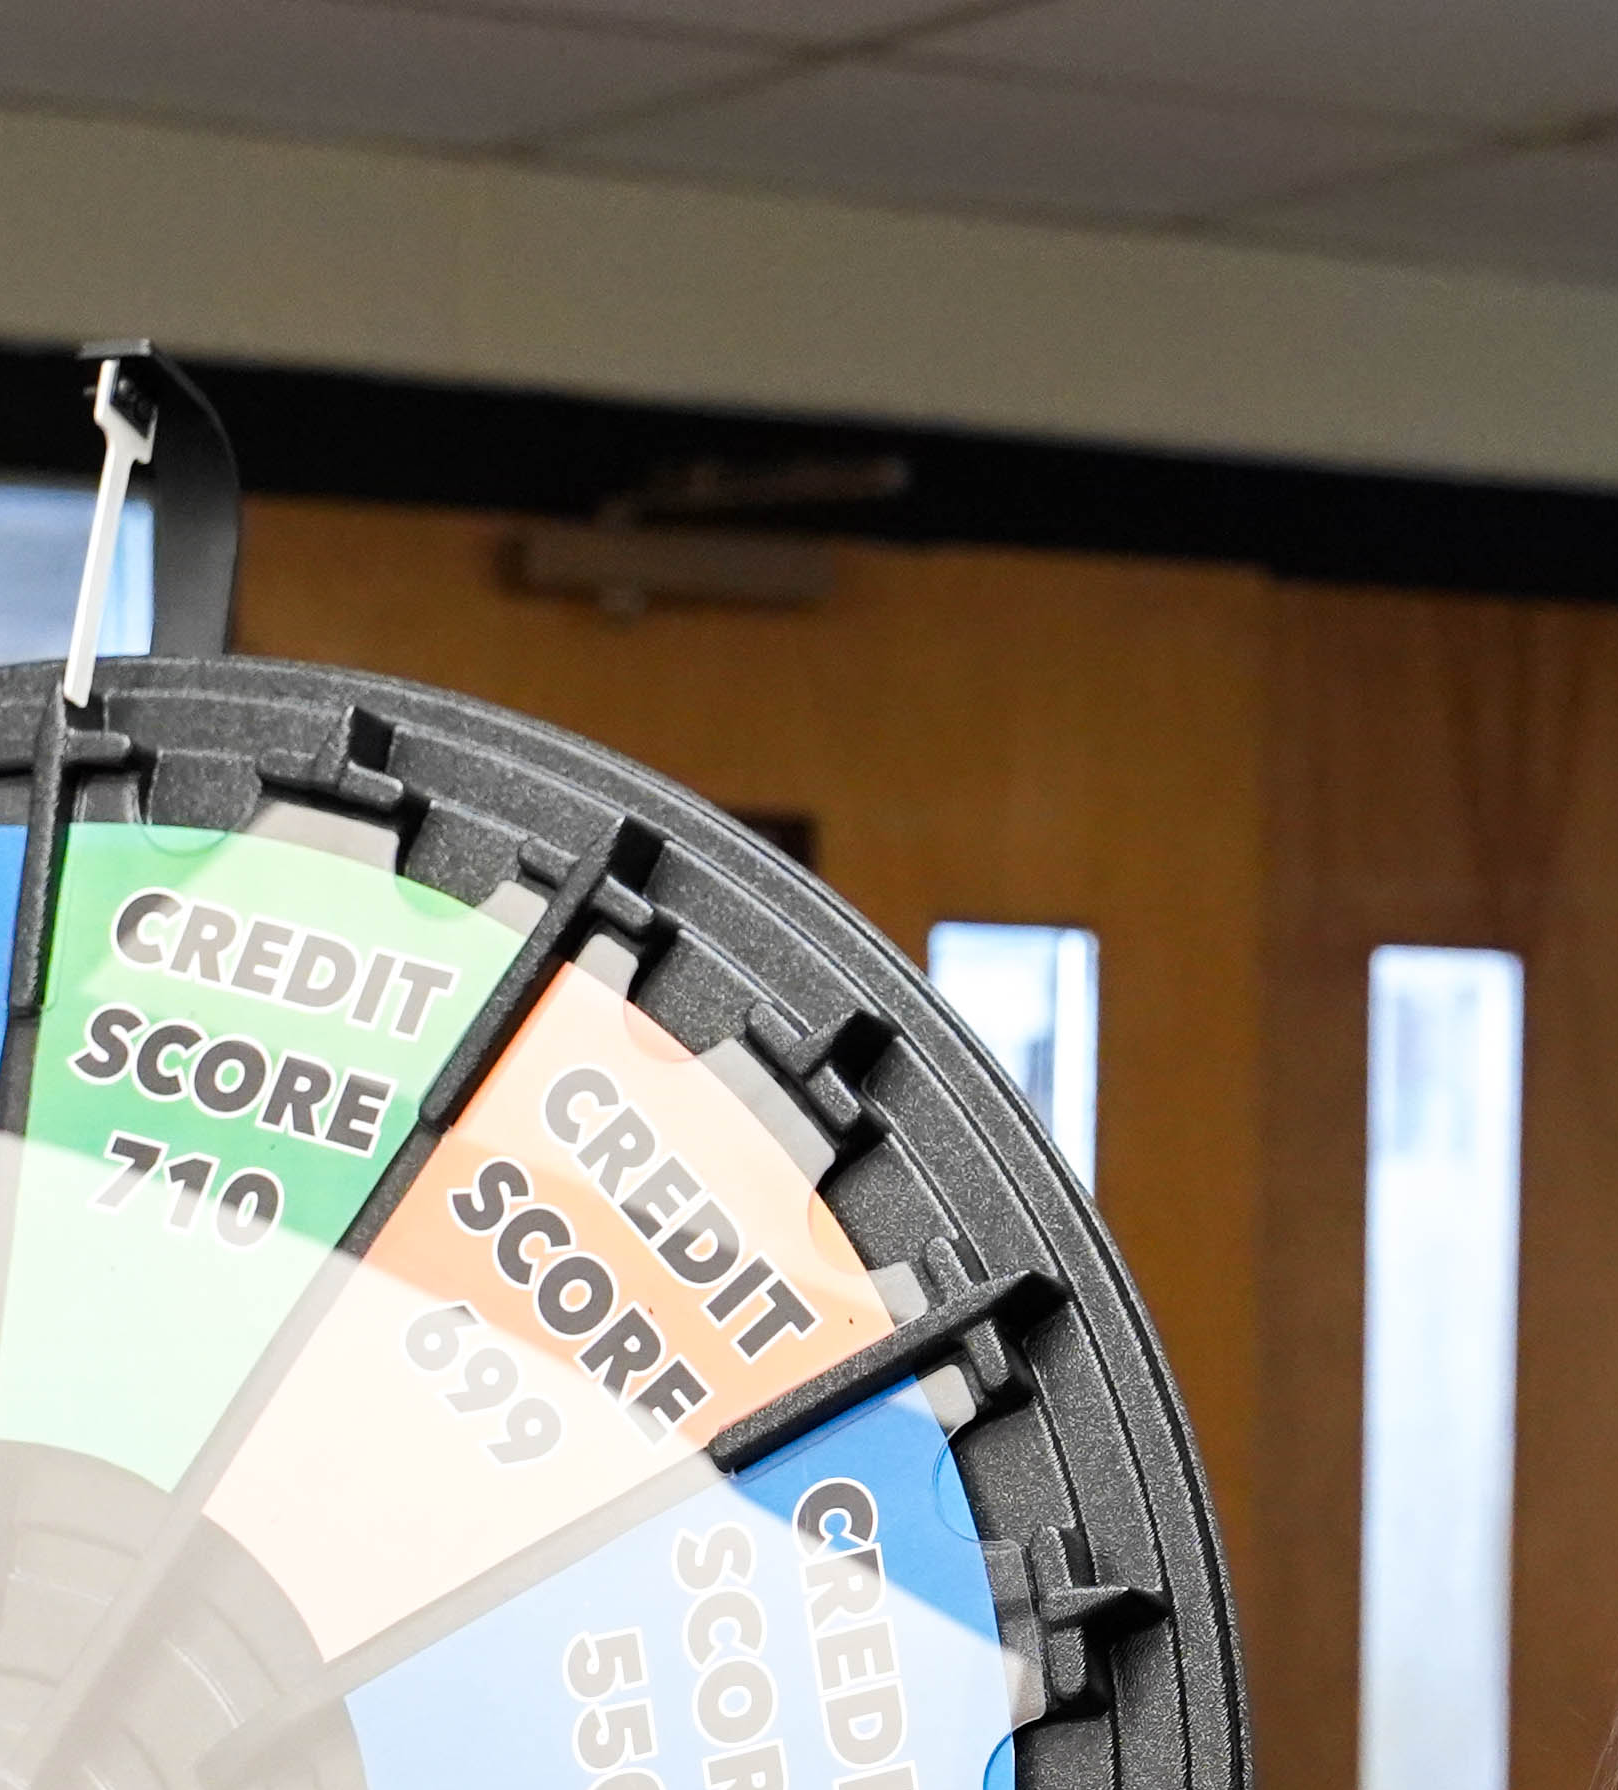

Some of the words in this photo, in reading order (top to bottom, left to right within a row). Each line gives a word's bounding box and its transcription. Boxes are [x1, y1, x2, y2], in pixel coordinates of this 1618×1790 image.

[116, 890, 457, 1037] CREDIT
[75, 1006, 392, 1152] SCORE
[103, 1135, 281, 1245] 710
[542, 1066, 819, 1359] CREDIT
[450, 1159, 710, 1443] SCORE
[407, 1303, 559, 1461] 699
